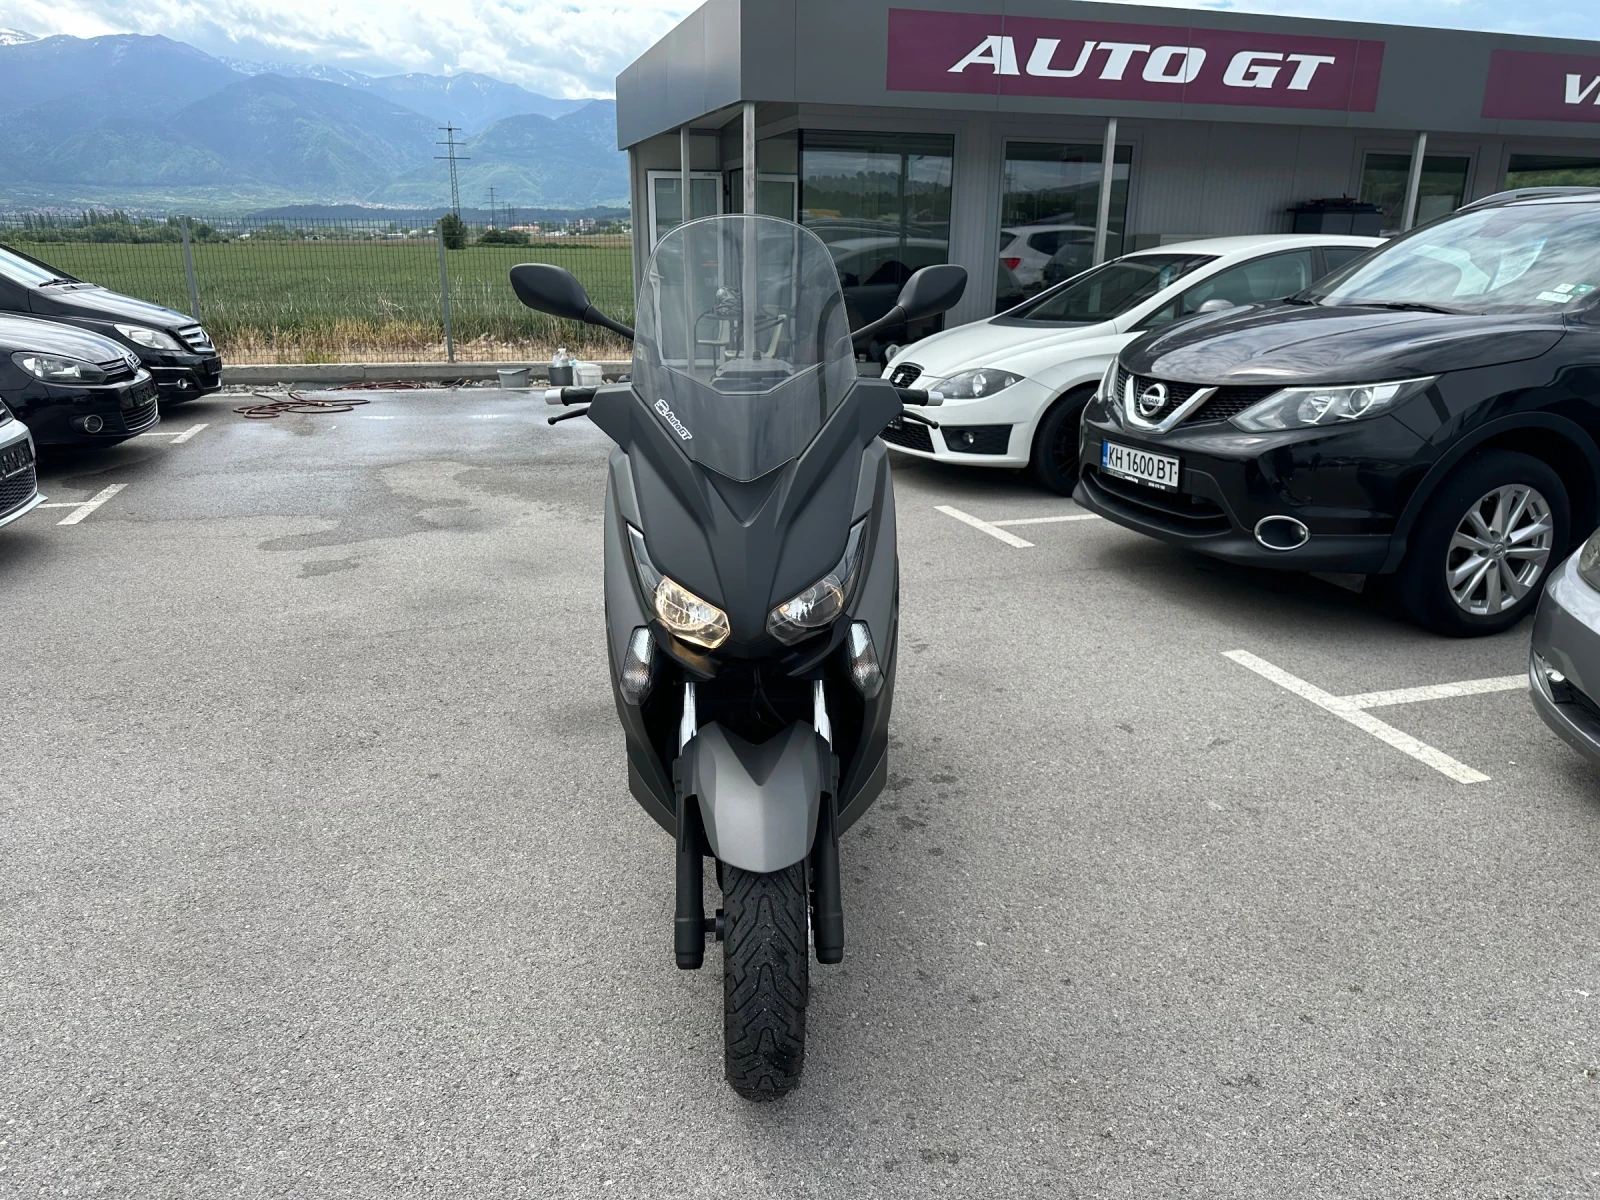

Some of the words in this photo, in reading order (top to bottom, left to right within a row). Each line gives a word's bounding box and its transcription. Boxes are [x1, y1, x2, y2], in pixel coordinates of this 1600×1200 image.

[947, 35, 1207, 84] AUTO
[1222, 51, 1336, 91] GT
[1565, 73, 1600, 105] V
[1109, 446, 1123, 469] KH
[1127, 451, 1154, 476] 1600
[1157, 459, 1176, 482] BT
